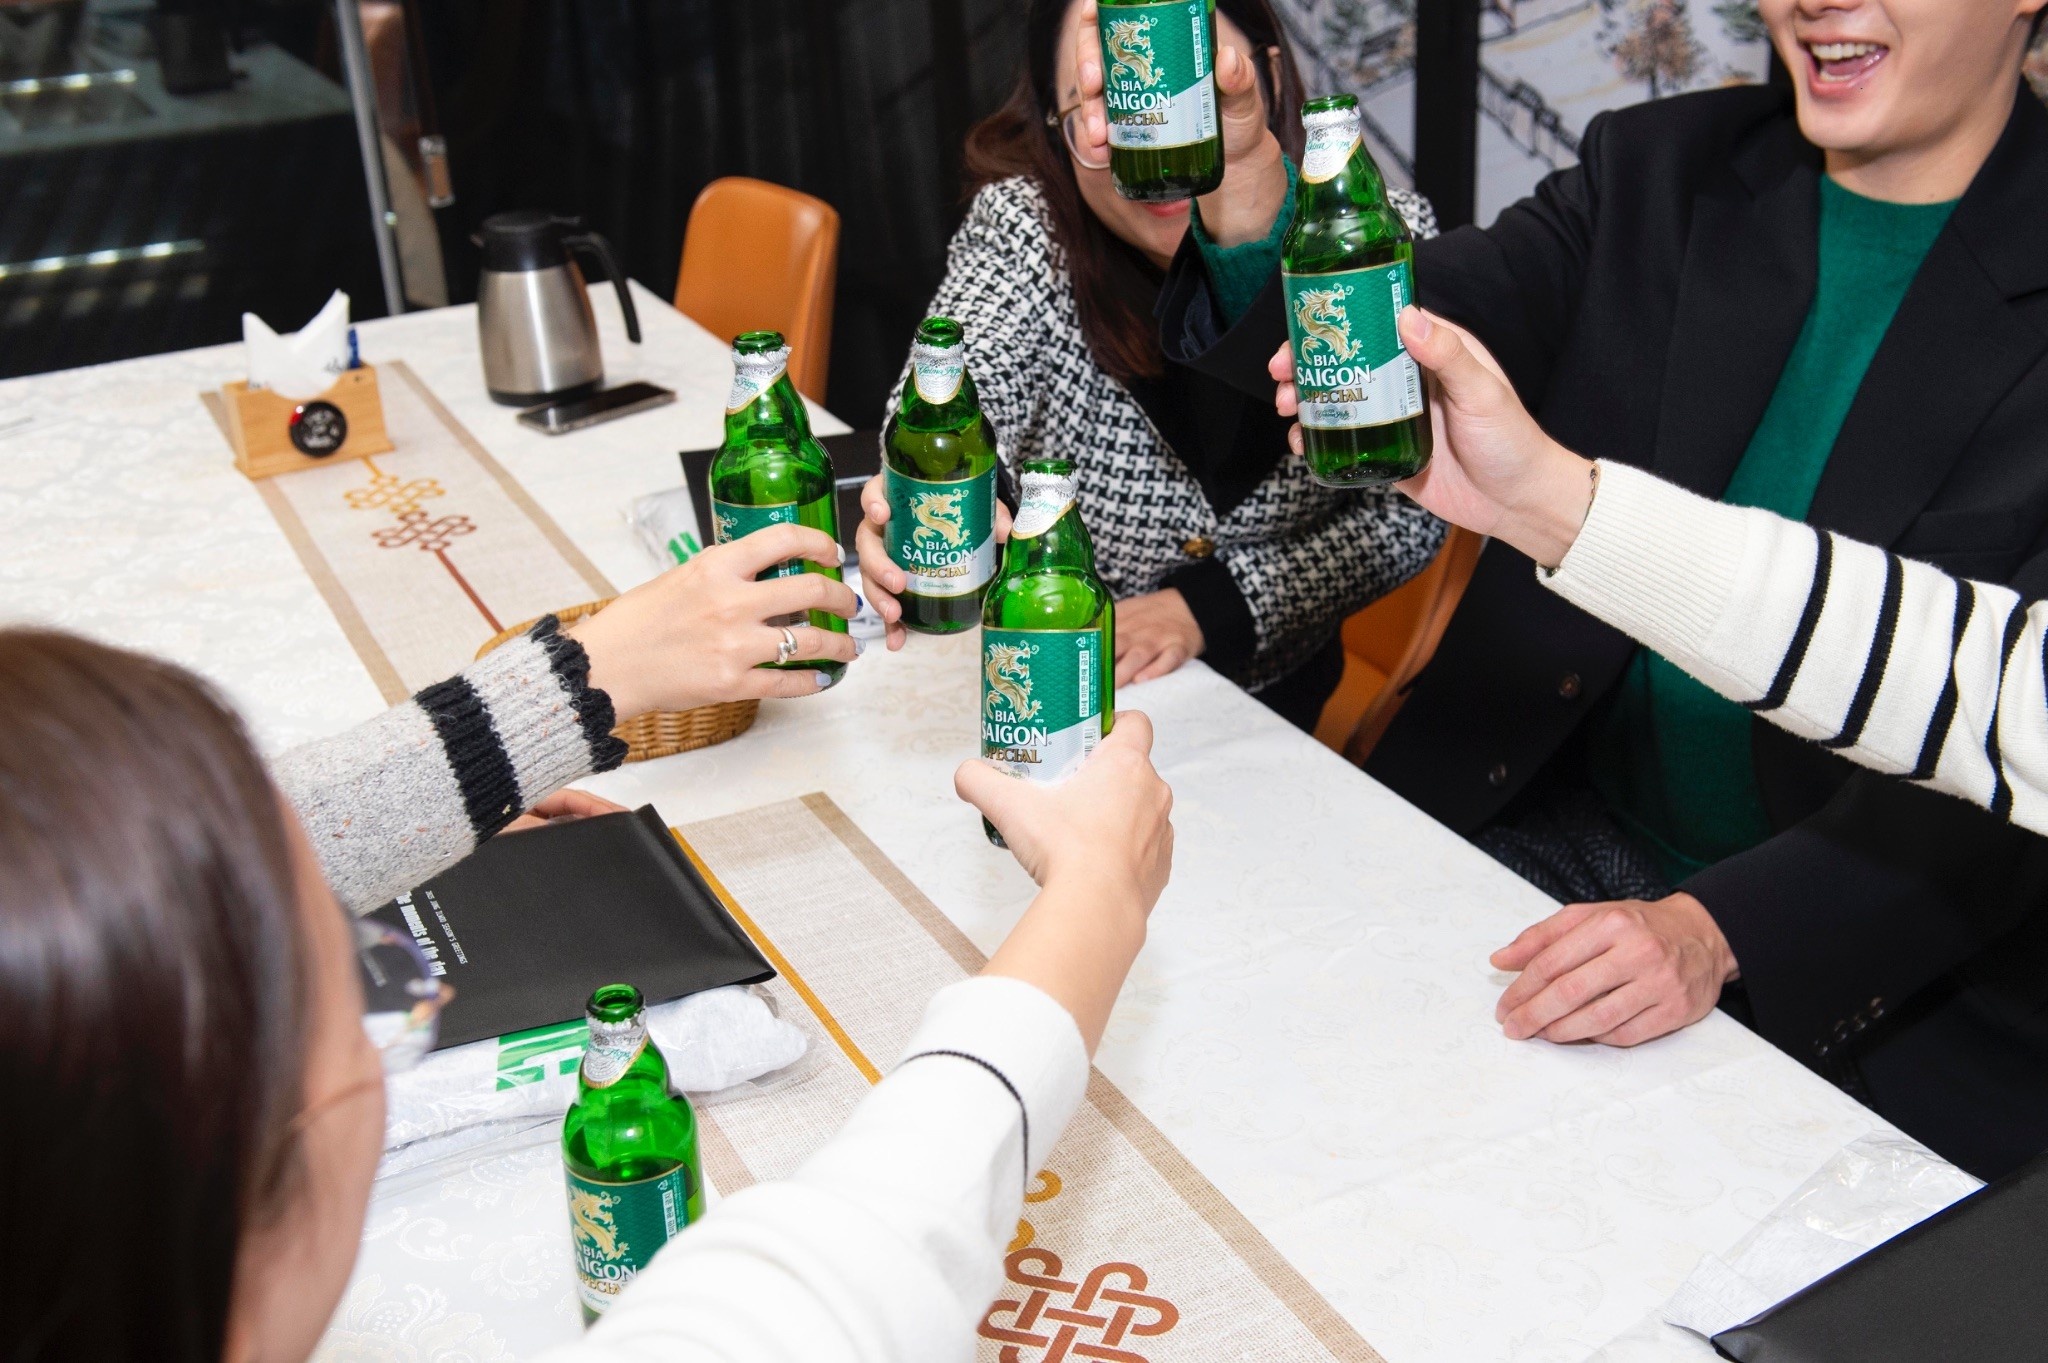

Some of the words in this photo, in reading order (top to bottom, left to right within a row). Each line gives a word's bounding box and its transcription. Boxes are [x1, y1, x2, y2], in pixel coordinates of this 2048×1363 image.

[1121, 80, 1142, 92] BIA
[1106, 91, 1172, 110] SAIGON
[1113, 112, 1168, 126] SPECIAL
[1314, 354, 1338, 367] BIA
[1297, 364, 1372, 387] SAIGON
[1304, 387, 1368, 404] SPECIAL
[926, 540, 949, 551] BIA
[902, 545, 974, 566] SAIGON
[909, 563, 970, 578] SPECIAL
[995, 710, 1017, 724] BIA
[982, 720, 1048, 746] SAIGON
[400, 904, 427, 938] moments
[416, 937, 435, 946] of
[442, 922, 457, 942] SEASON'S
[451, 941, 468, 964] GREETINGS
[421, 946, 439, 960] the
[428, 960, 447, 977] day
[583, 1244, 605, 1261] BIA
[576, 1251, 638, 1282] AIGON
